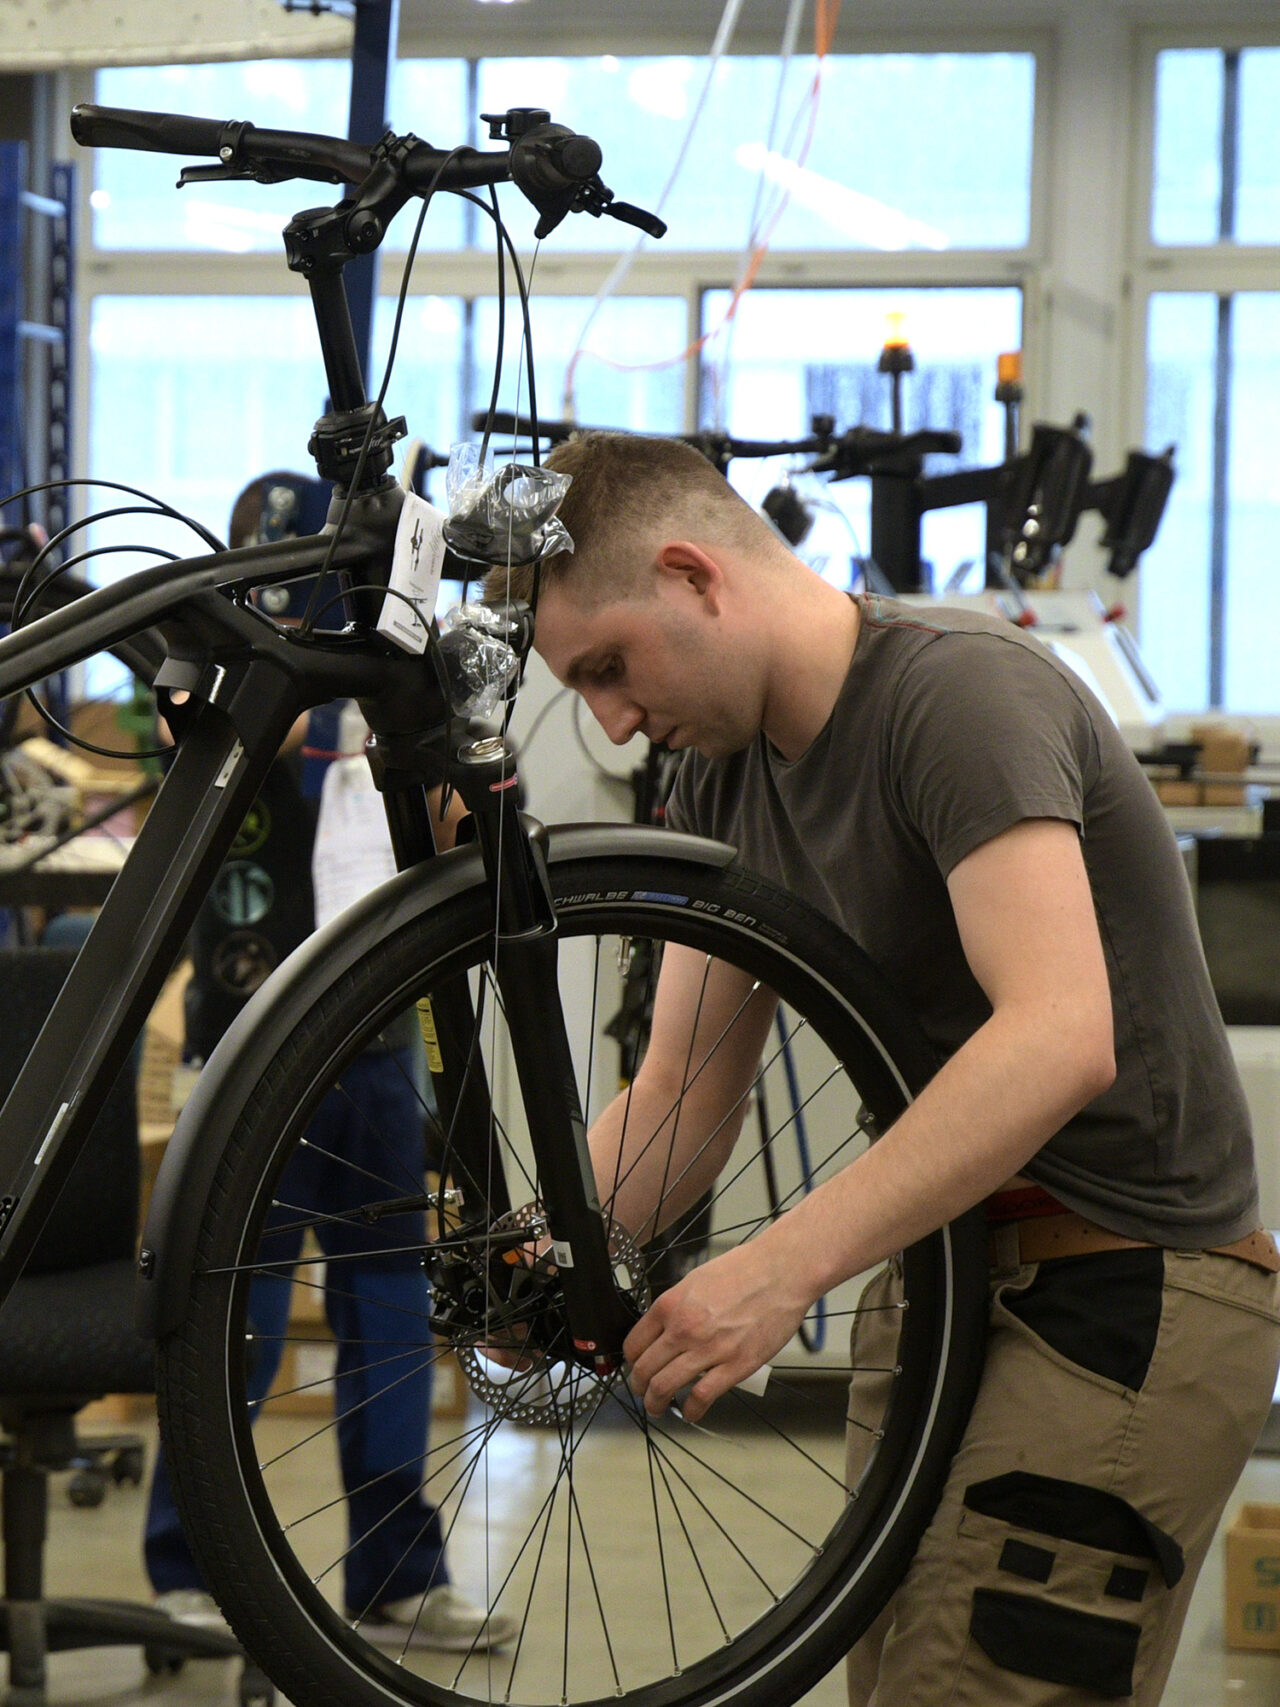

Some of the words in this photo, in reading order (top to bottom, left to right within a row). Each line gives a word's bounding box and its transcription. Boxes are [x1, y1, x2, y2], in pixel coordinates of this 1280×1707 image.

[553, 890, 629, 907] CHWALBE
[691, 899, 721, 913] BIG
[723, 908, 758, 927] BEN
